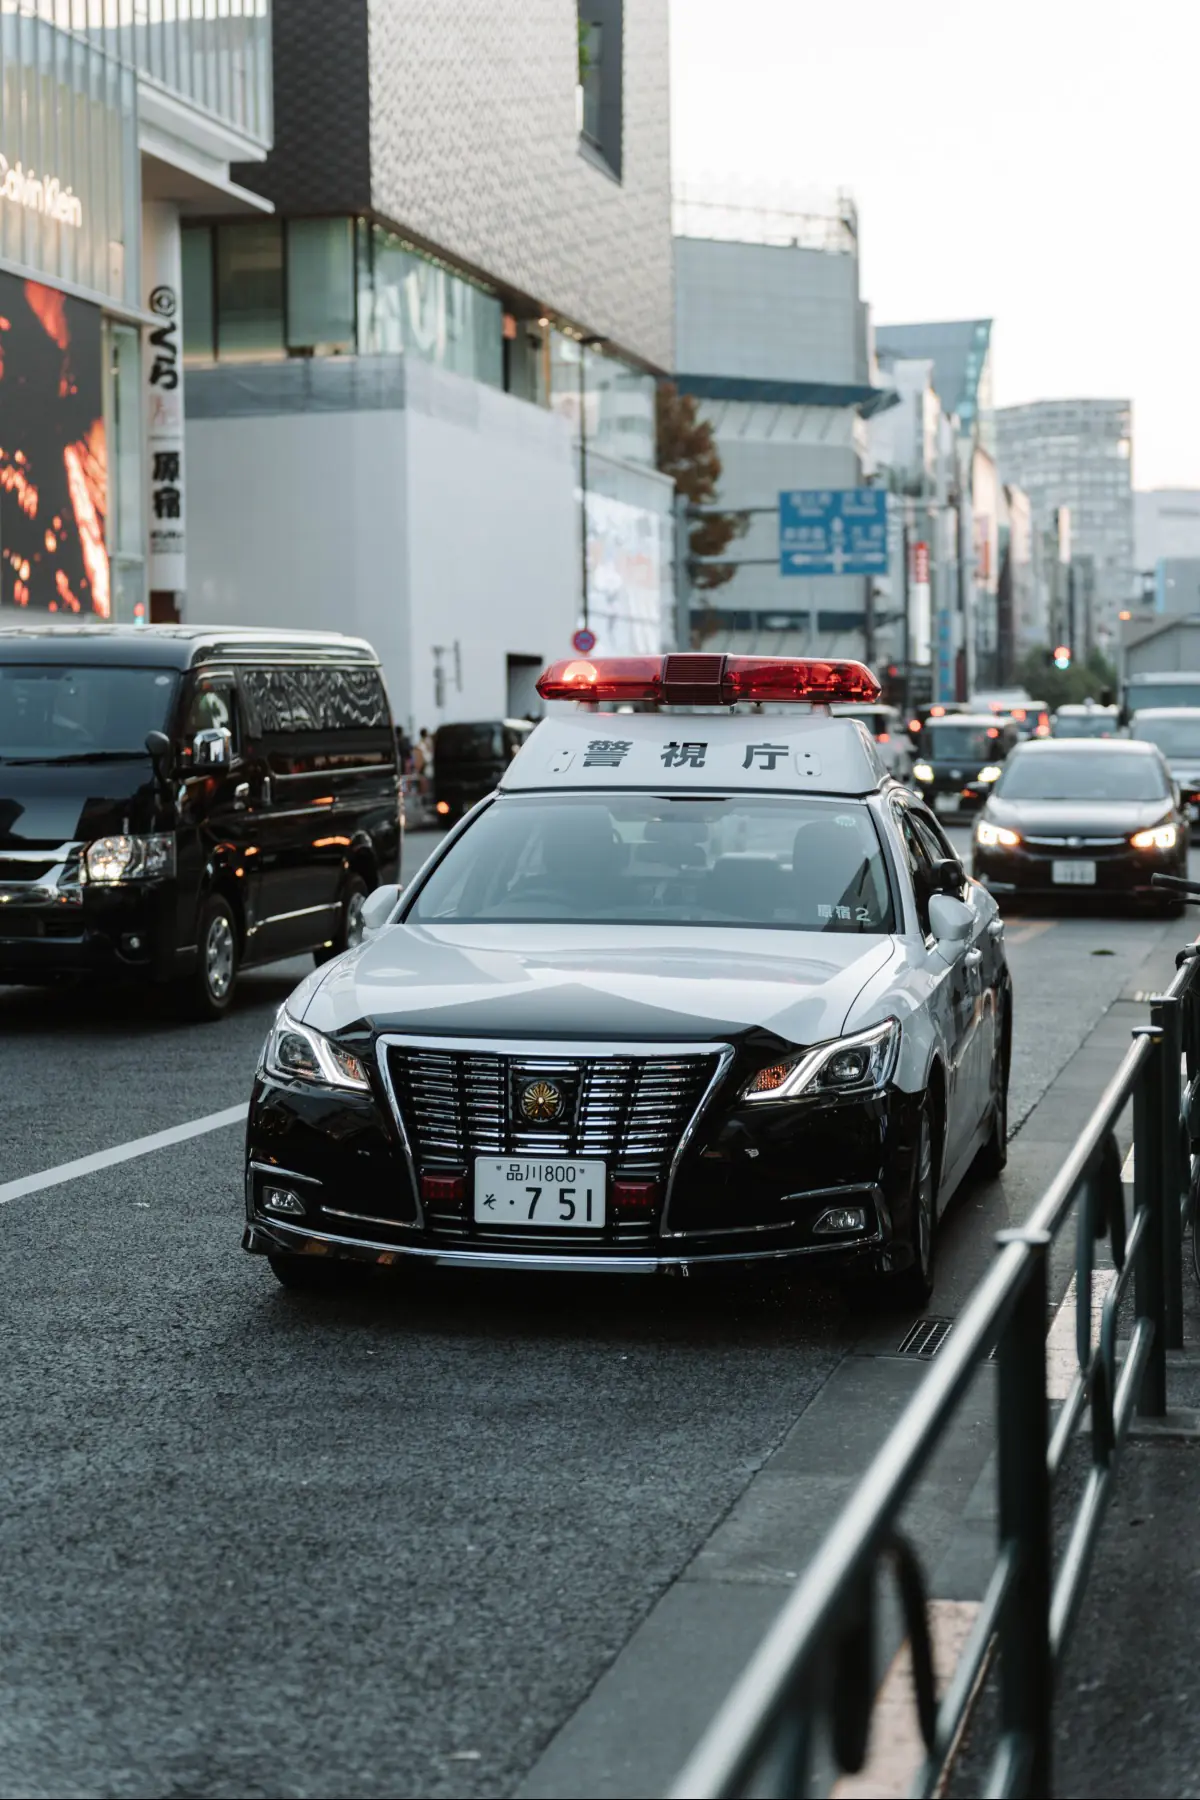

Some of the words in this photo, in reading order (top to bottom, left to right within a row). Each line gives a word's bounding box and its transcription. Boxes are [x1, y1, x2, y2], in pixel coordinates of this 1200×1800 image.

[149, 322, 179, 390] くら
[152, 450, 181, 520] 原宿
[582, 739, 789, 770] 警視庁
